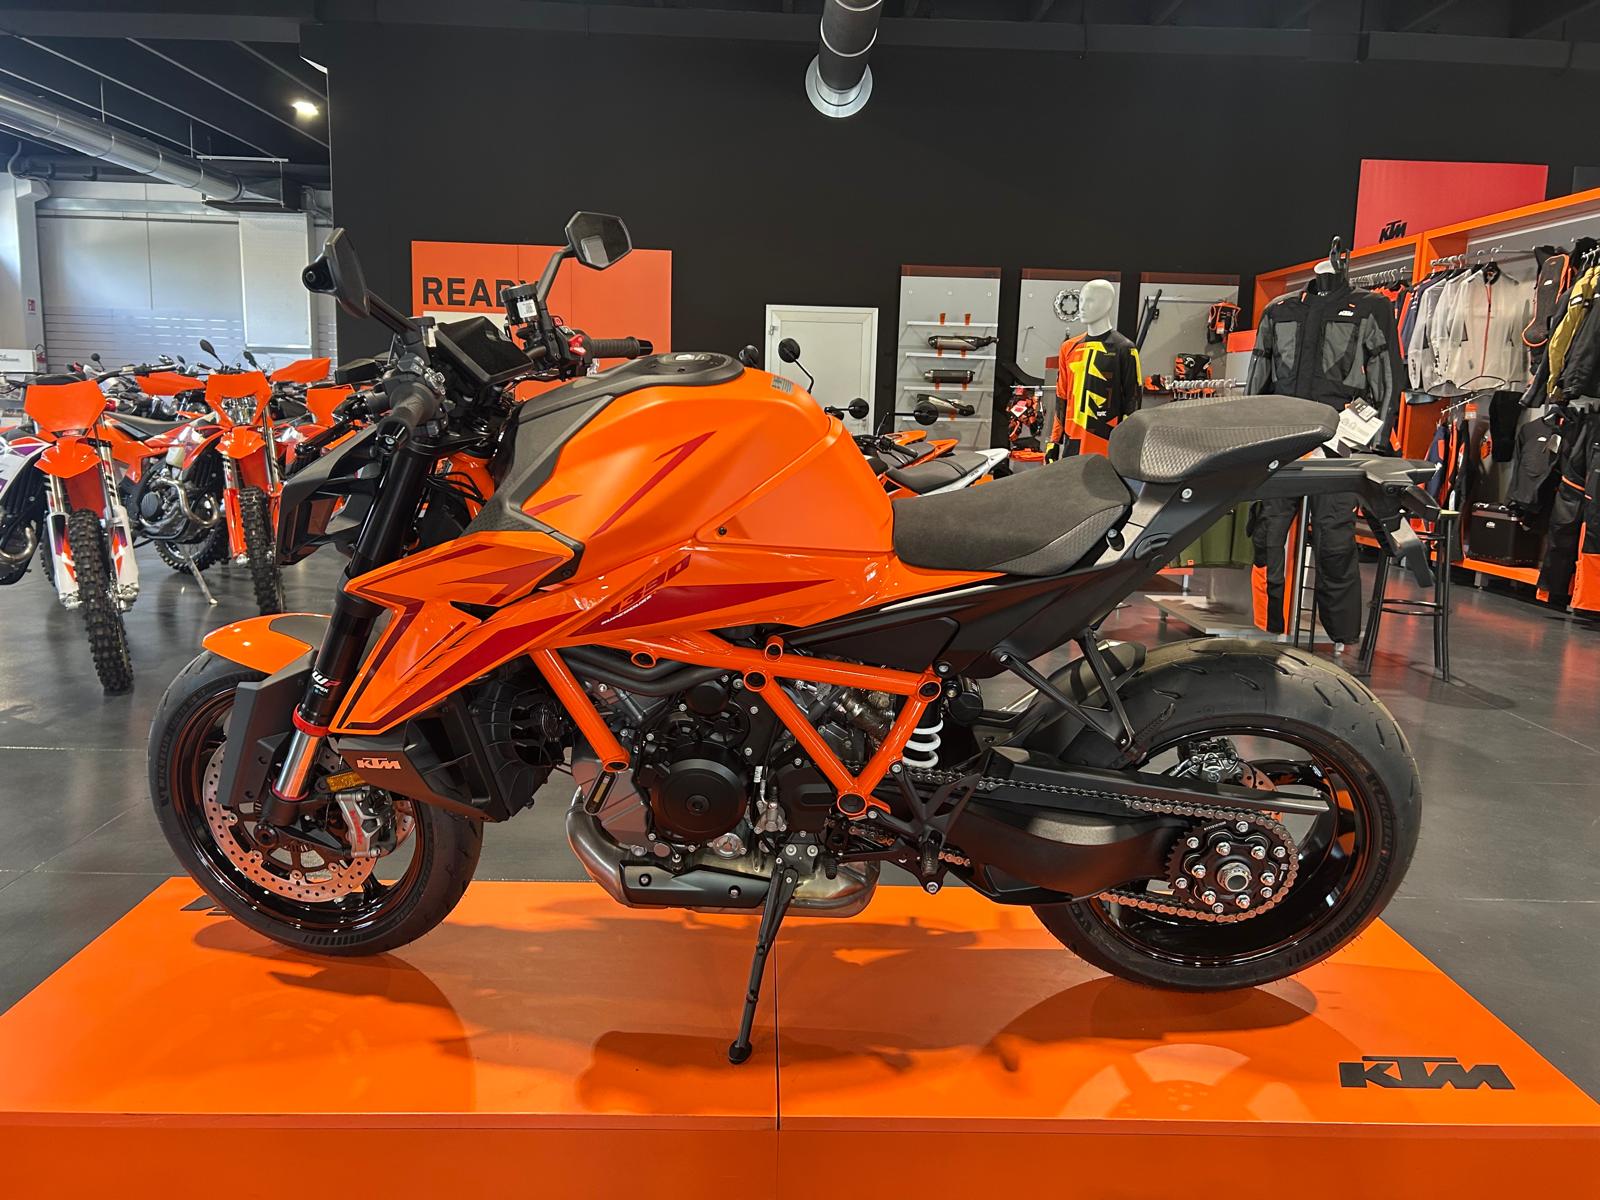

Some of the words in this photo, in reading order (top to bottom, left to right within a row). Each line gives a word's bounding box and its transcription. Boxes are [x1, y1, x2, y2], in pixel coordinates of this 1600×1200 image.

[1379, 220, 1408, 244] KTM
[356, 757, 402, 770] KTM
[1338, 1055, 1516, 1090] KTM
